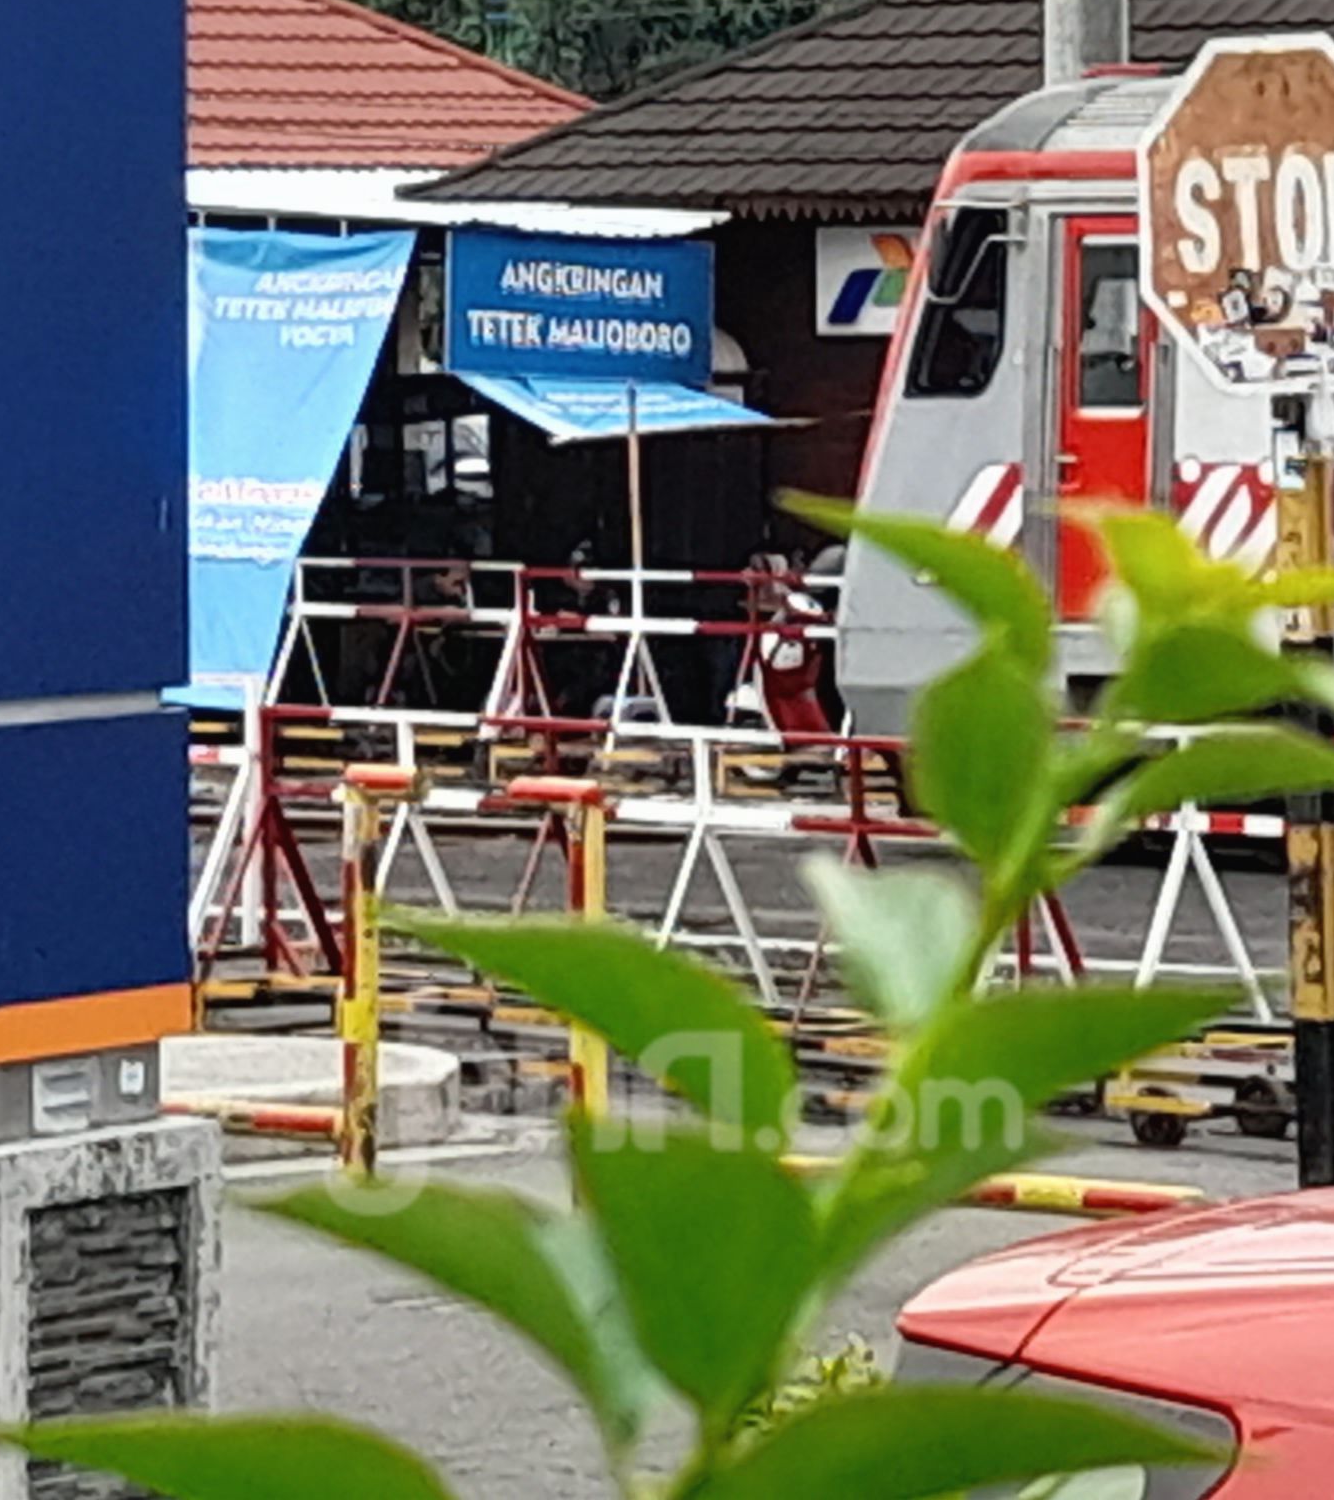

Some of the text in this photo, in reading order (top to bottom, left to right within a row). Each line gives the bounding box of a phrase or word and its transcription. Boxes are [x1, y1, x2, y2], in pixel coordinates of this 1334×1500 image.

[500, 259, 664, 299] ANGKRINGAN
[467, 309, 692, 356] TETEK MALIOBORO
